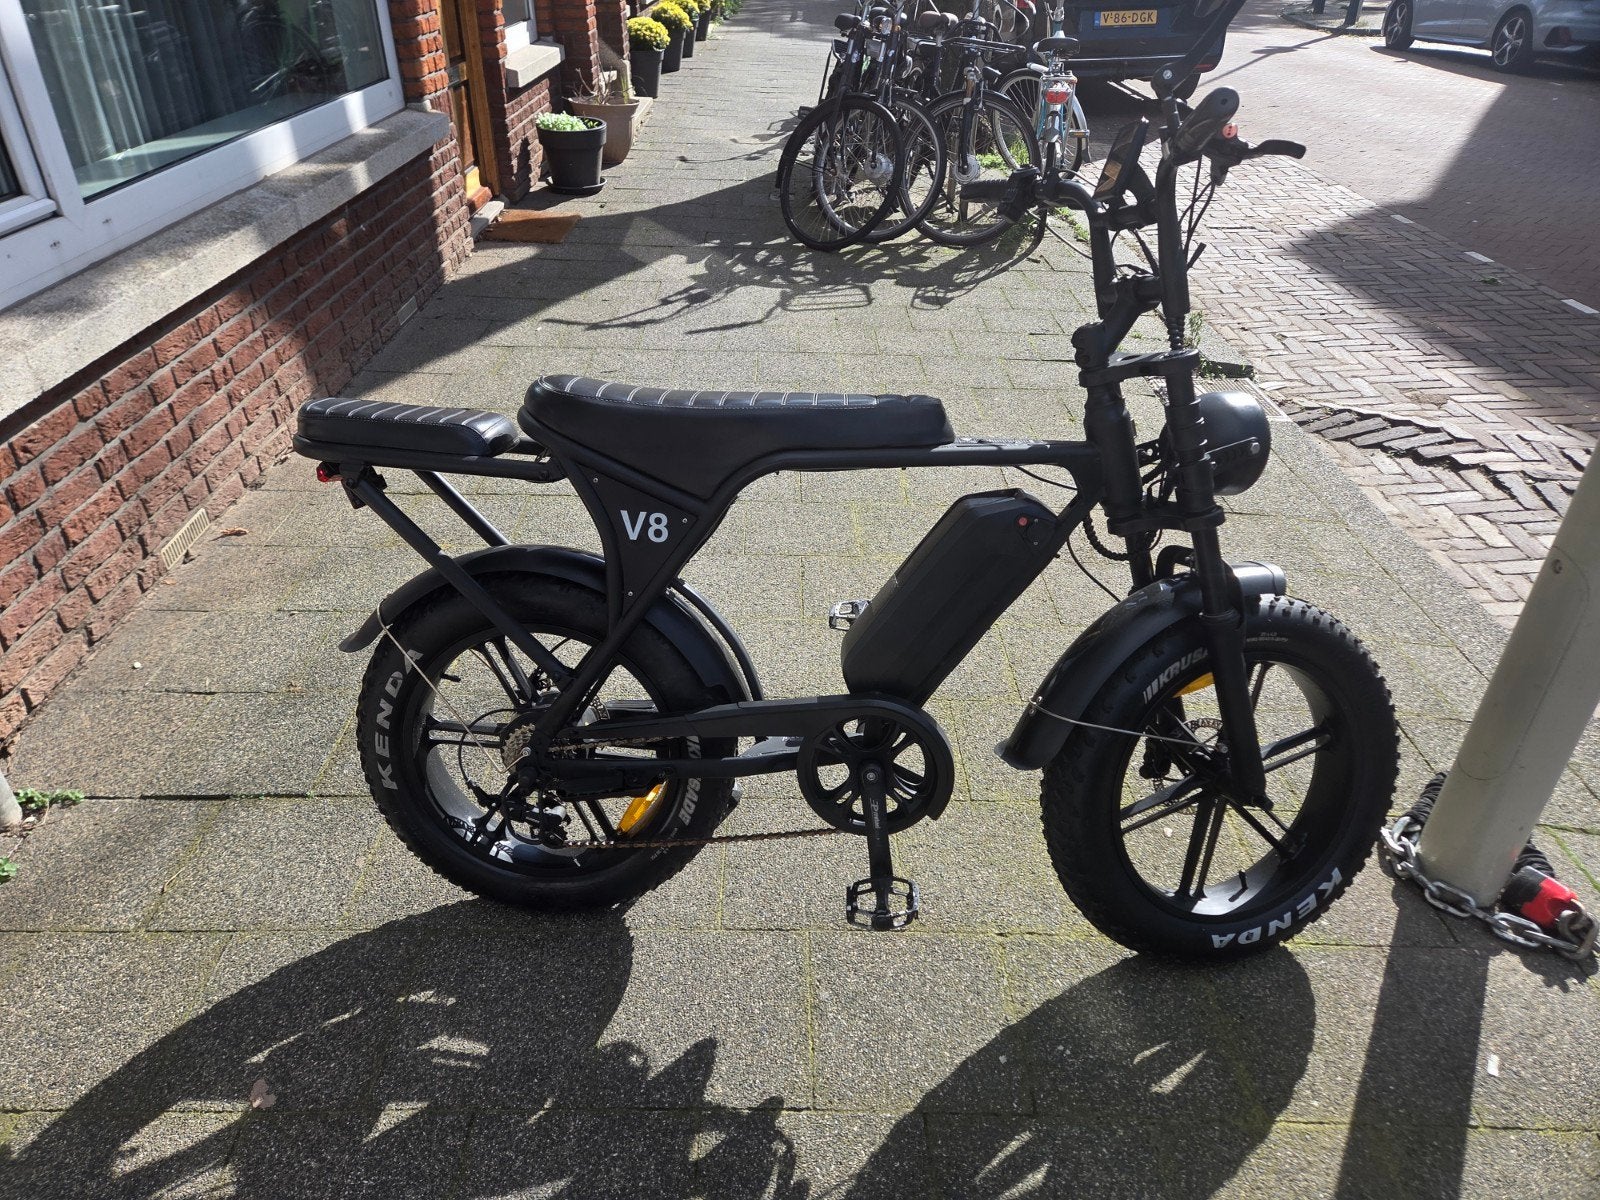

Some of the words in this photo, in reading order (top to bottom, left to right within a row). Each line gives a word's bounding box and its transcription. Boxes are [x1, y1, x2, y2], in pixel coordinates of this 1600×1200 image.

[1103, 12, 1154, 23] V-86-DGK
[620, 509, 669, 543] V8
[374, 649, 424, 790] KENDA
[1211, 866, 1343, 949] KENDA
